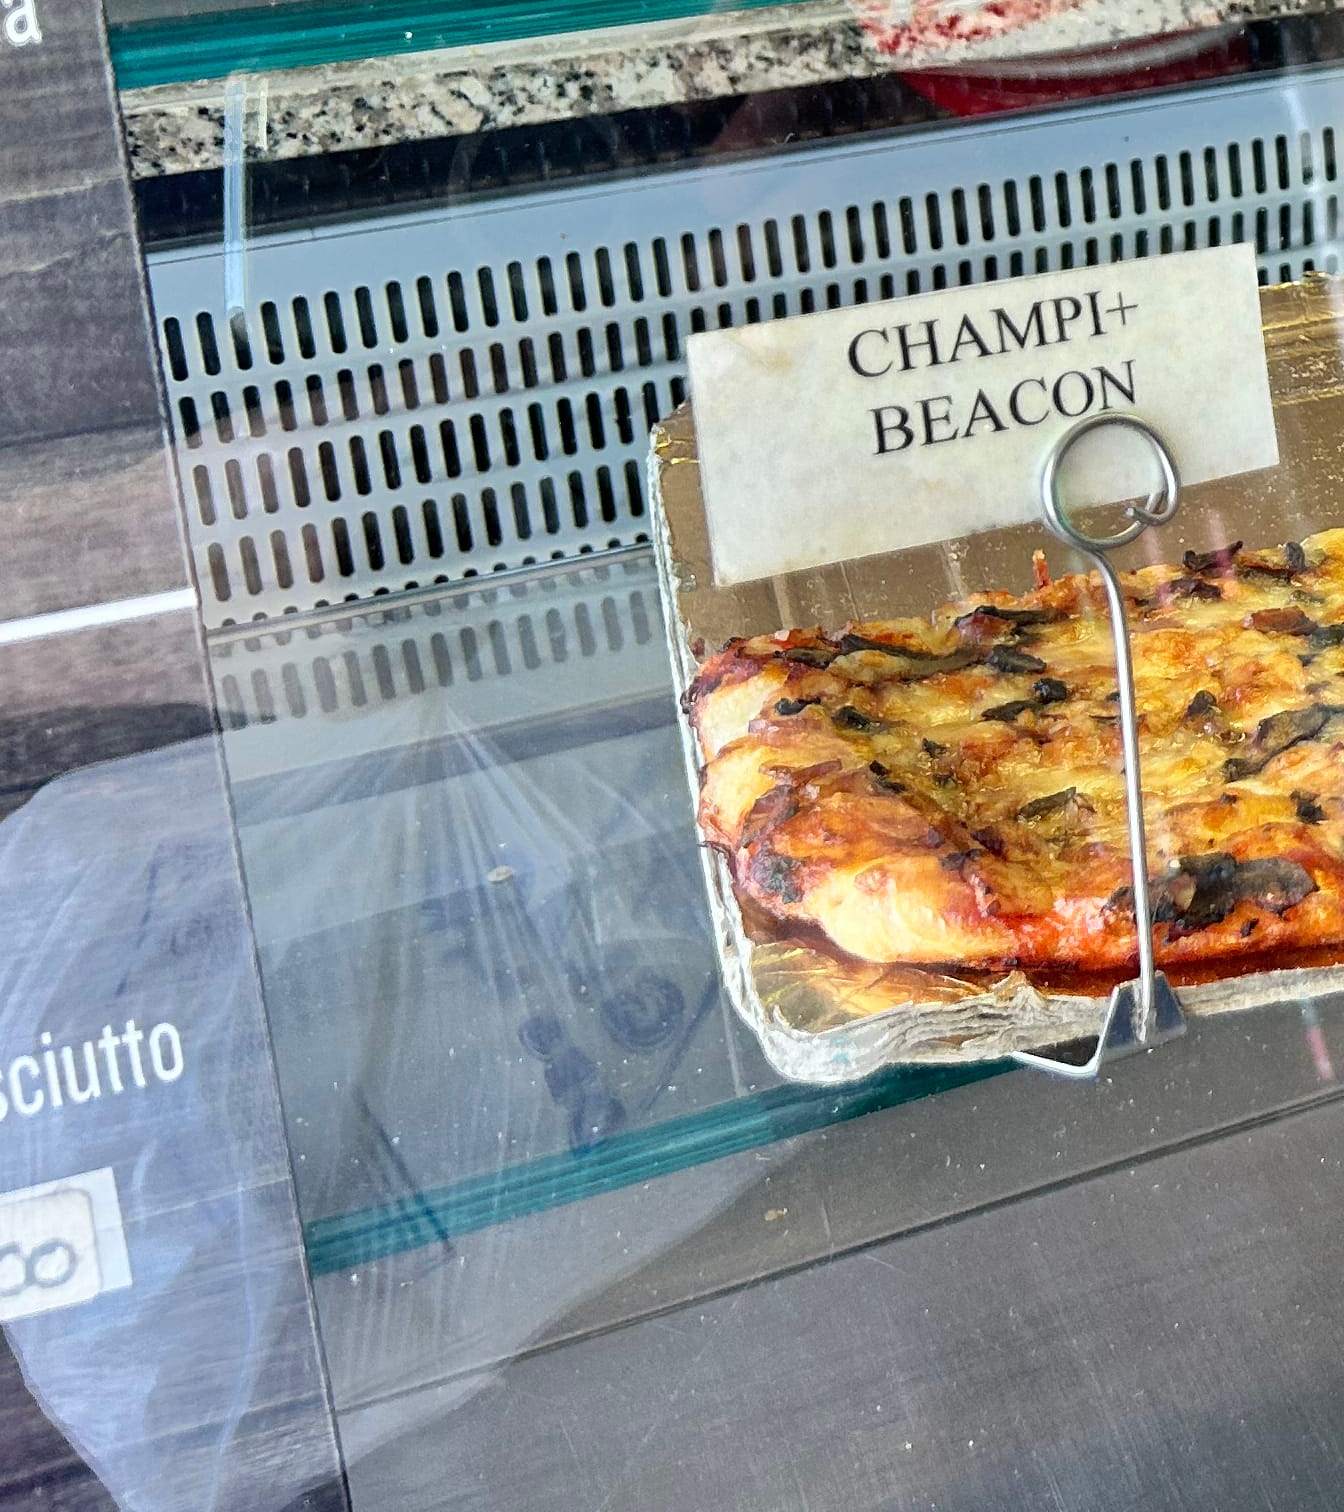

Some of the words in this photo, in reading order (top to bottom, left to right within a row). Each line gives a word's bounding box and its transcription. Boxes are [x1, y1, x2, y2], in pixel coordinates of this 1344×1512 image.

[848, 290, 1140, 378] CHAMPI+
[869, 360, 1138, 456] BEACON
[0, 1019, 185, 1123] ciutto
